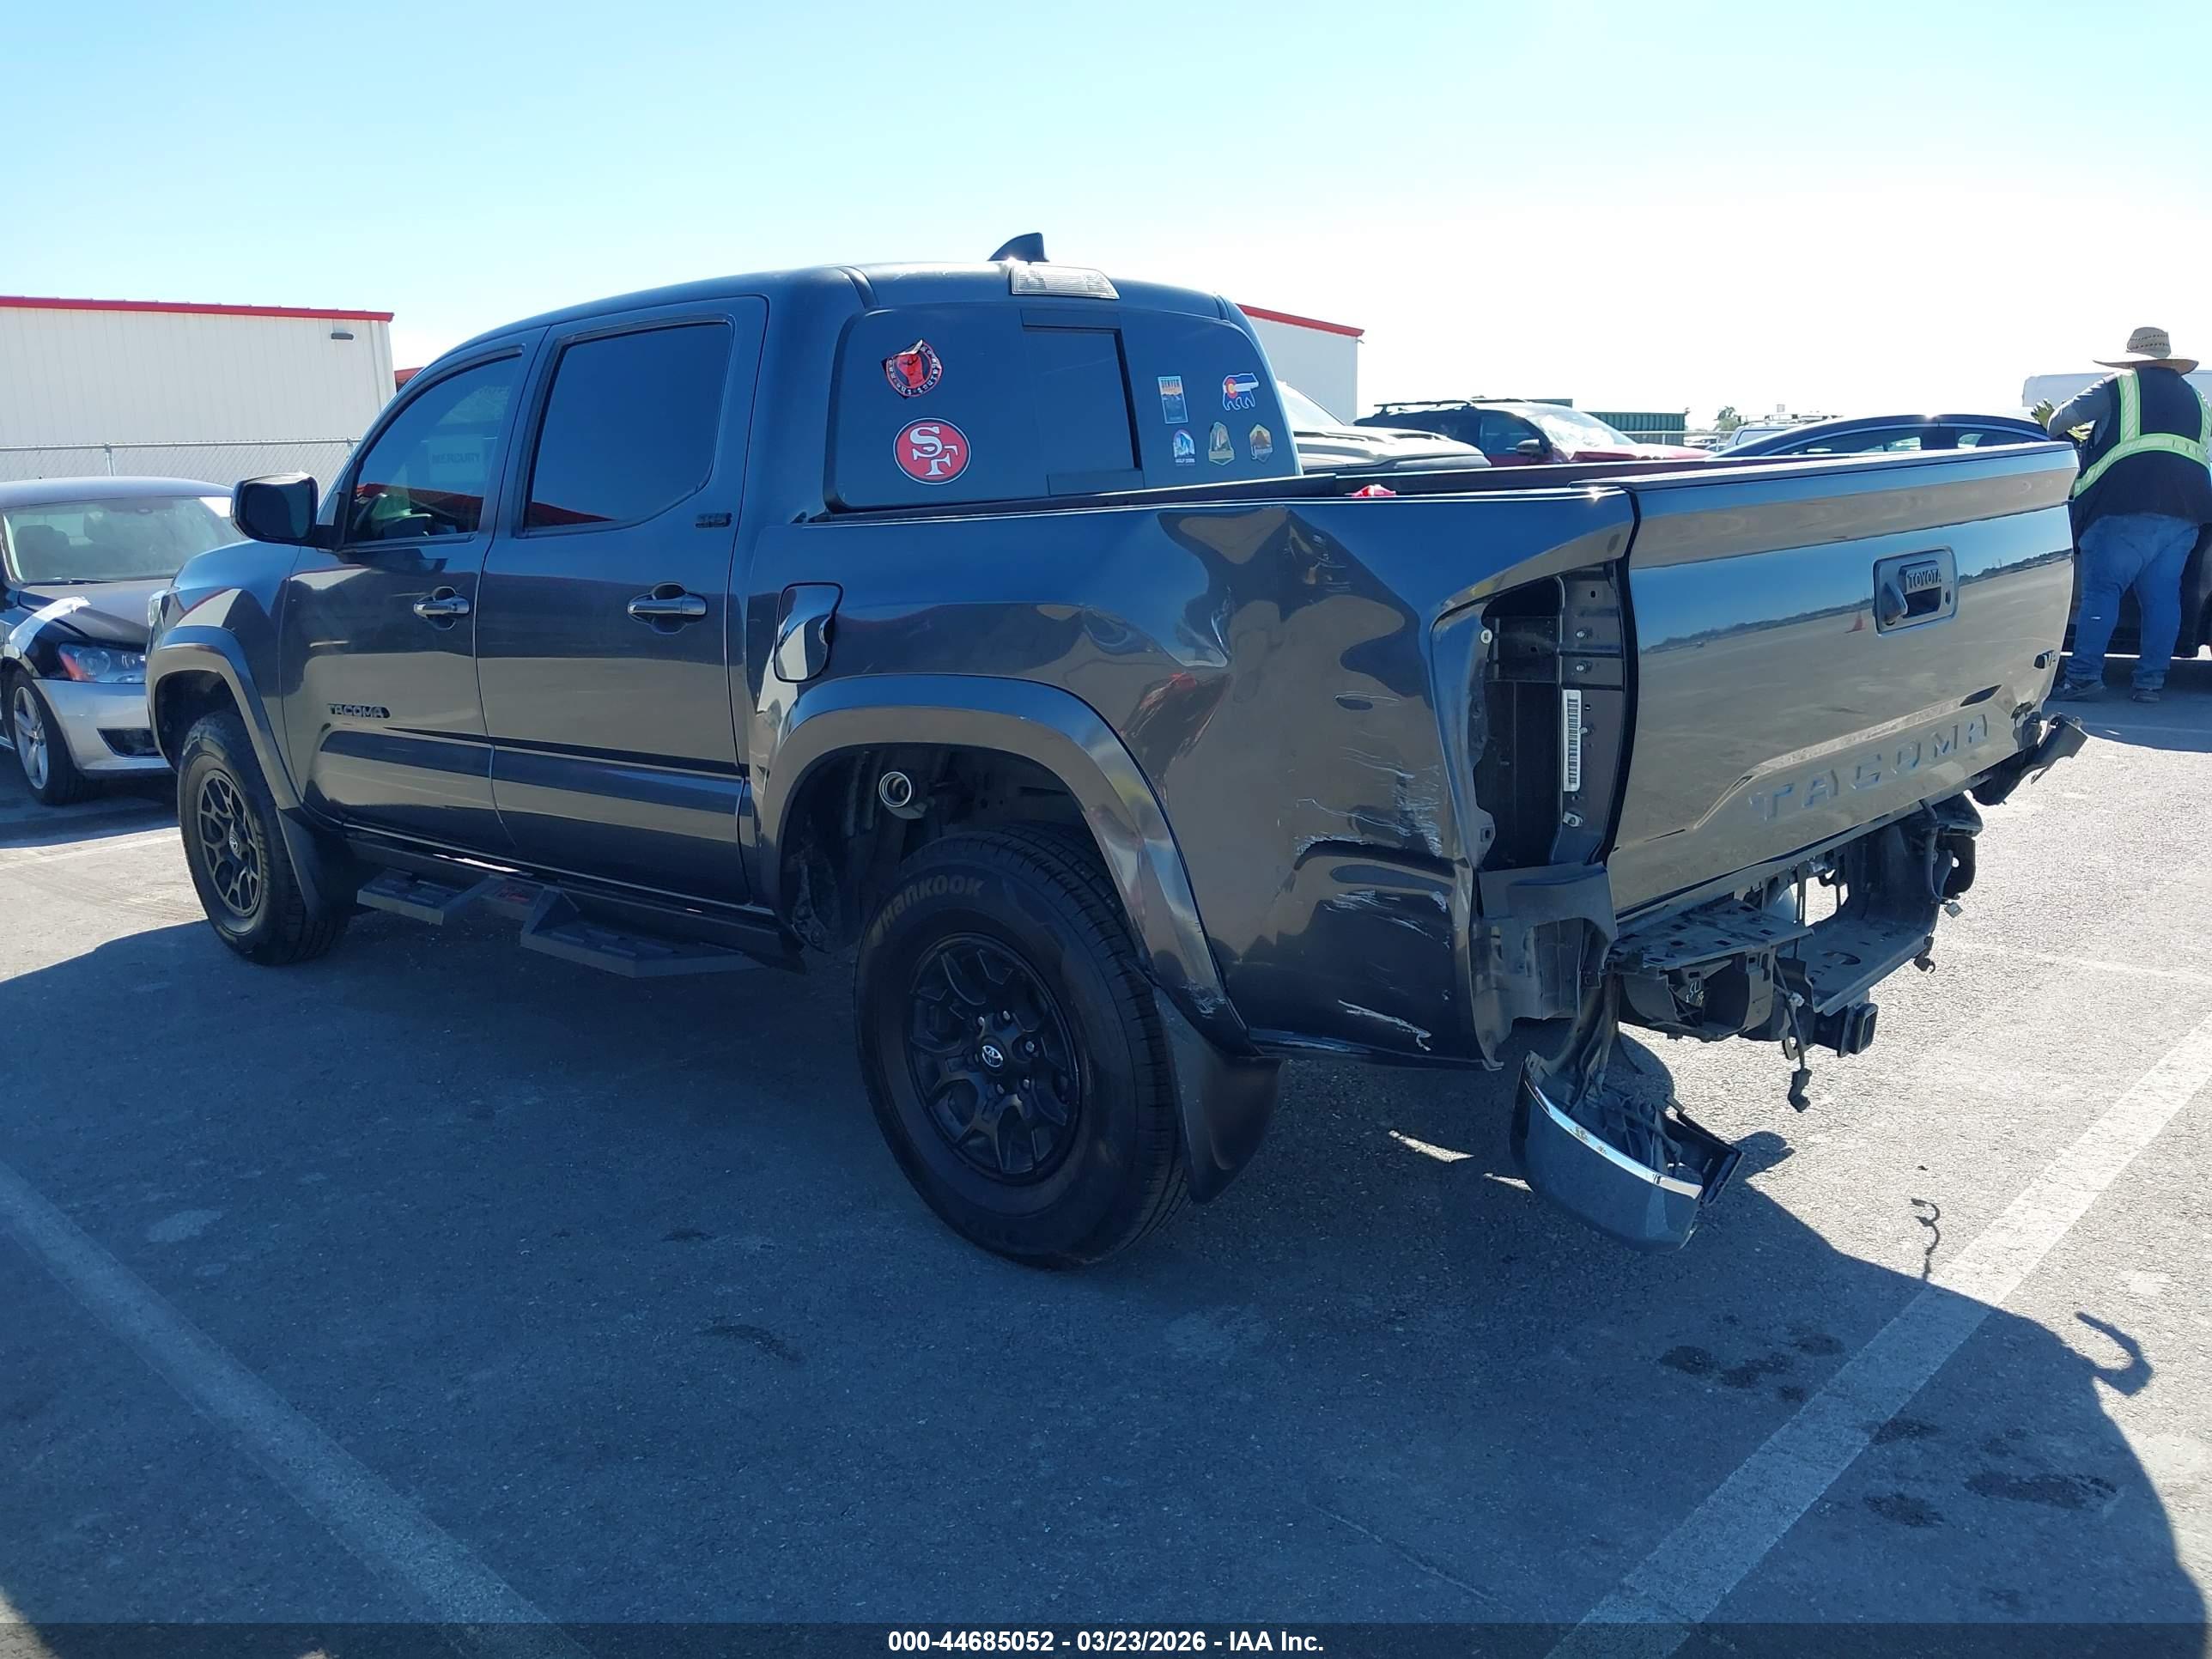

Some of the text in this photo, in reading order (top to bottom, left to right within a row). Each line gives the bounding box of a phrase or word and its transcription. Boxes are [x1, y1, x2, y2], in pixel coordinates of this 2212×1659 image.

[909, 426, 958, 476] SF
[1908, 569, 1942, 589] TOYOTA
[327, 703, 385, 719] TACOMA
[1748, 714, 1988, 822] TACOMA
